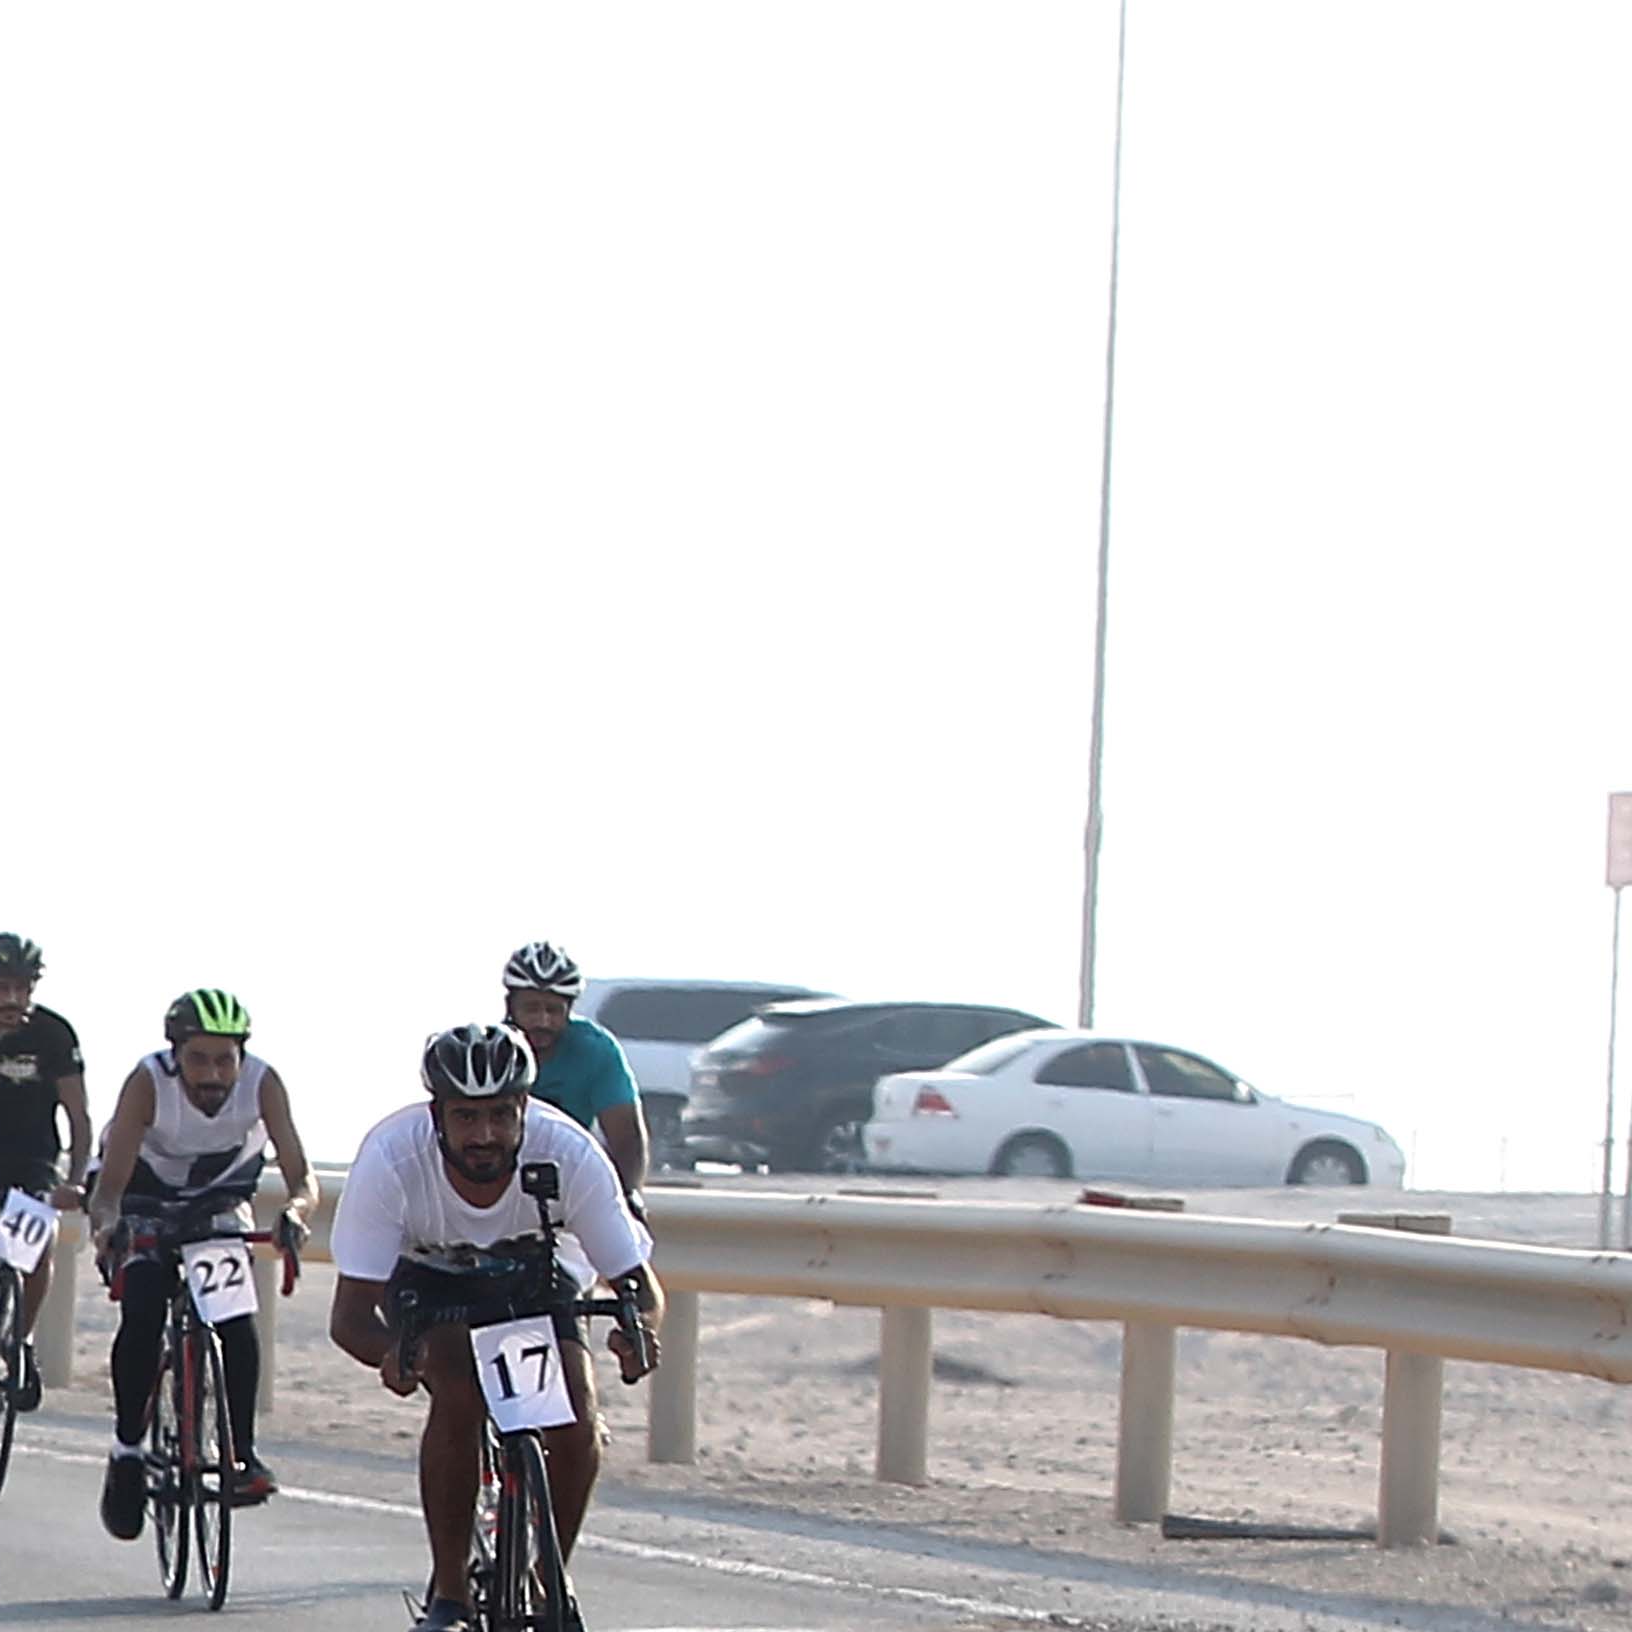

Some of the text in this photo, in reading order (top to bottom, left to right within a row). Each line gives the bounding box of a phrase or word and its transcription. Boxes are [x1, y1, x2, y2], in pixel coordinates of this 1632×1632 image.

[1, 1208, 48, 1246] 40
[193, 1256, 246, 1298] 22
[489, 1342, 552, 1401] 17
